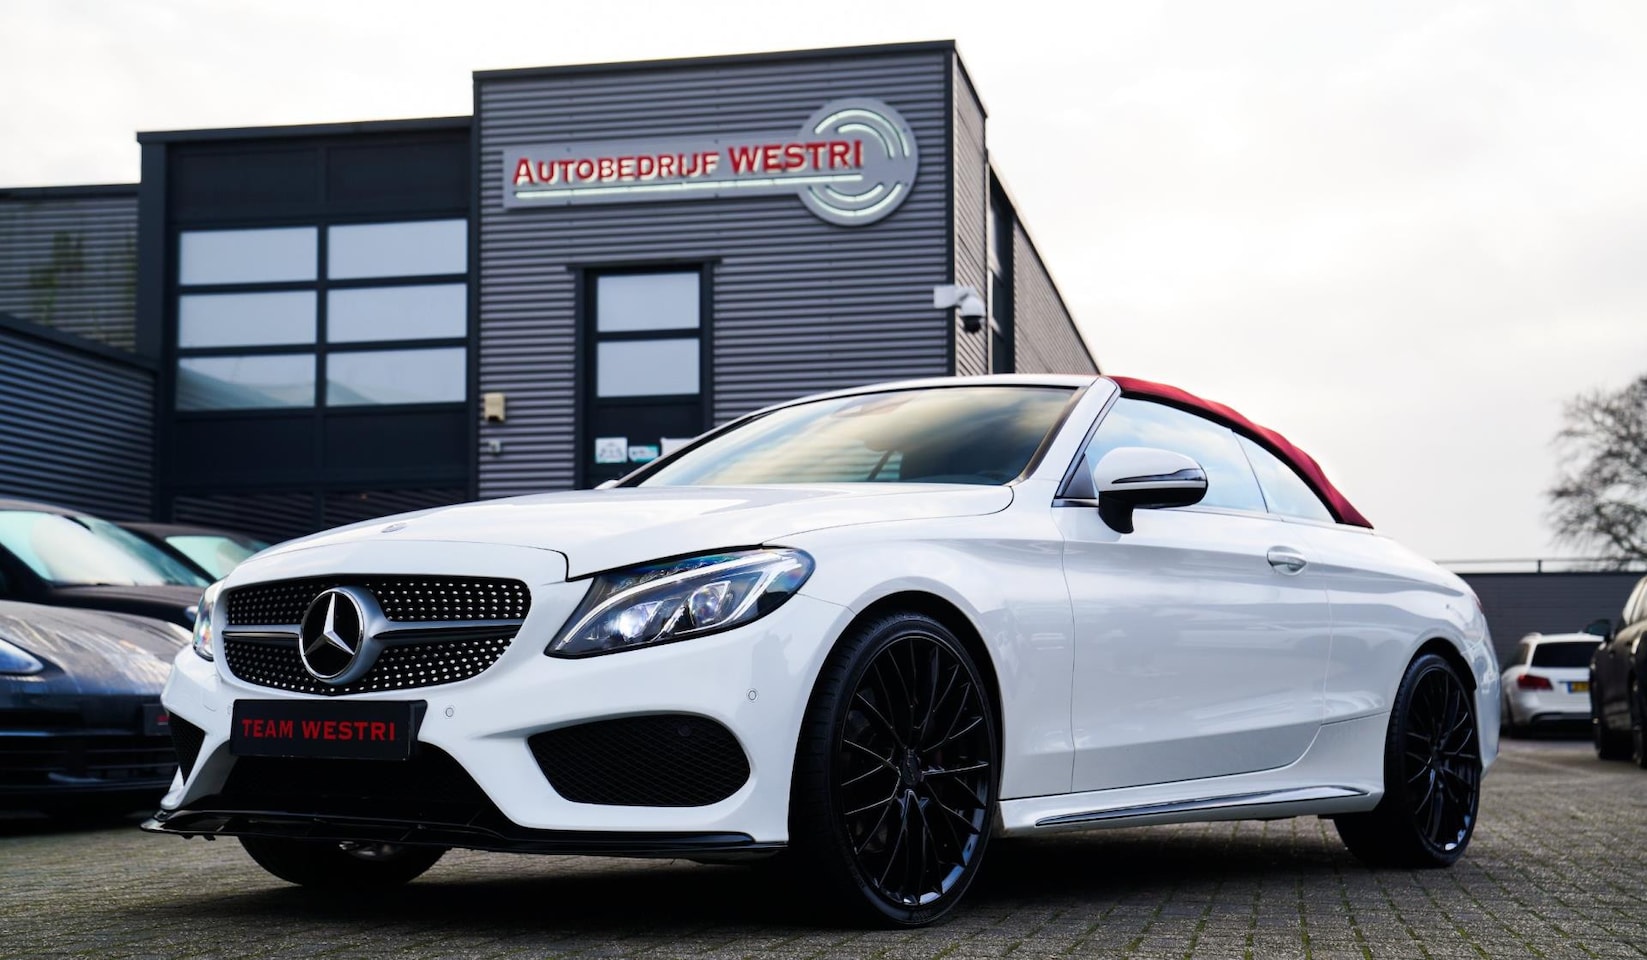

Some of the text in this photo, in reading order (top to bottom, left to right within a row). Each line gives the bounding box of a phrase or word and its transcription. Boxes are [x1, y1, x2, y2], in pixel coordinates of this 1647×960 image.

[513, 140, 863, 185] AUTOBEDRIJF WESTRI
[242, 719, 396, 742] TEAM WESTRI
